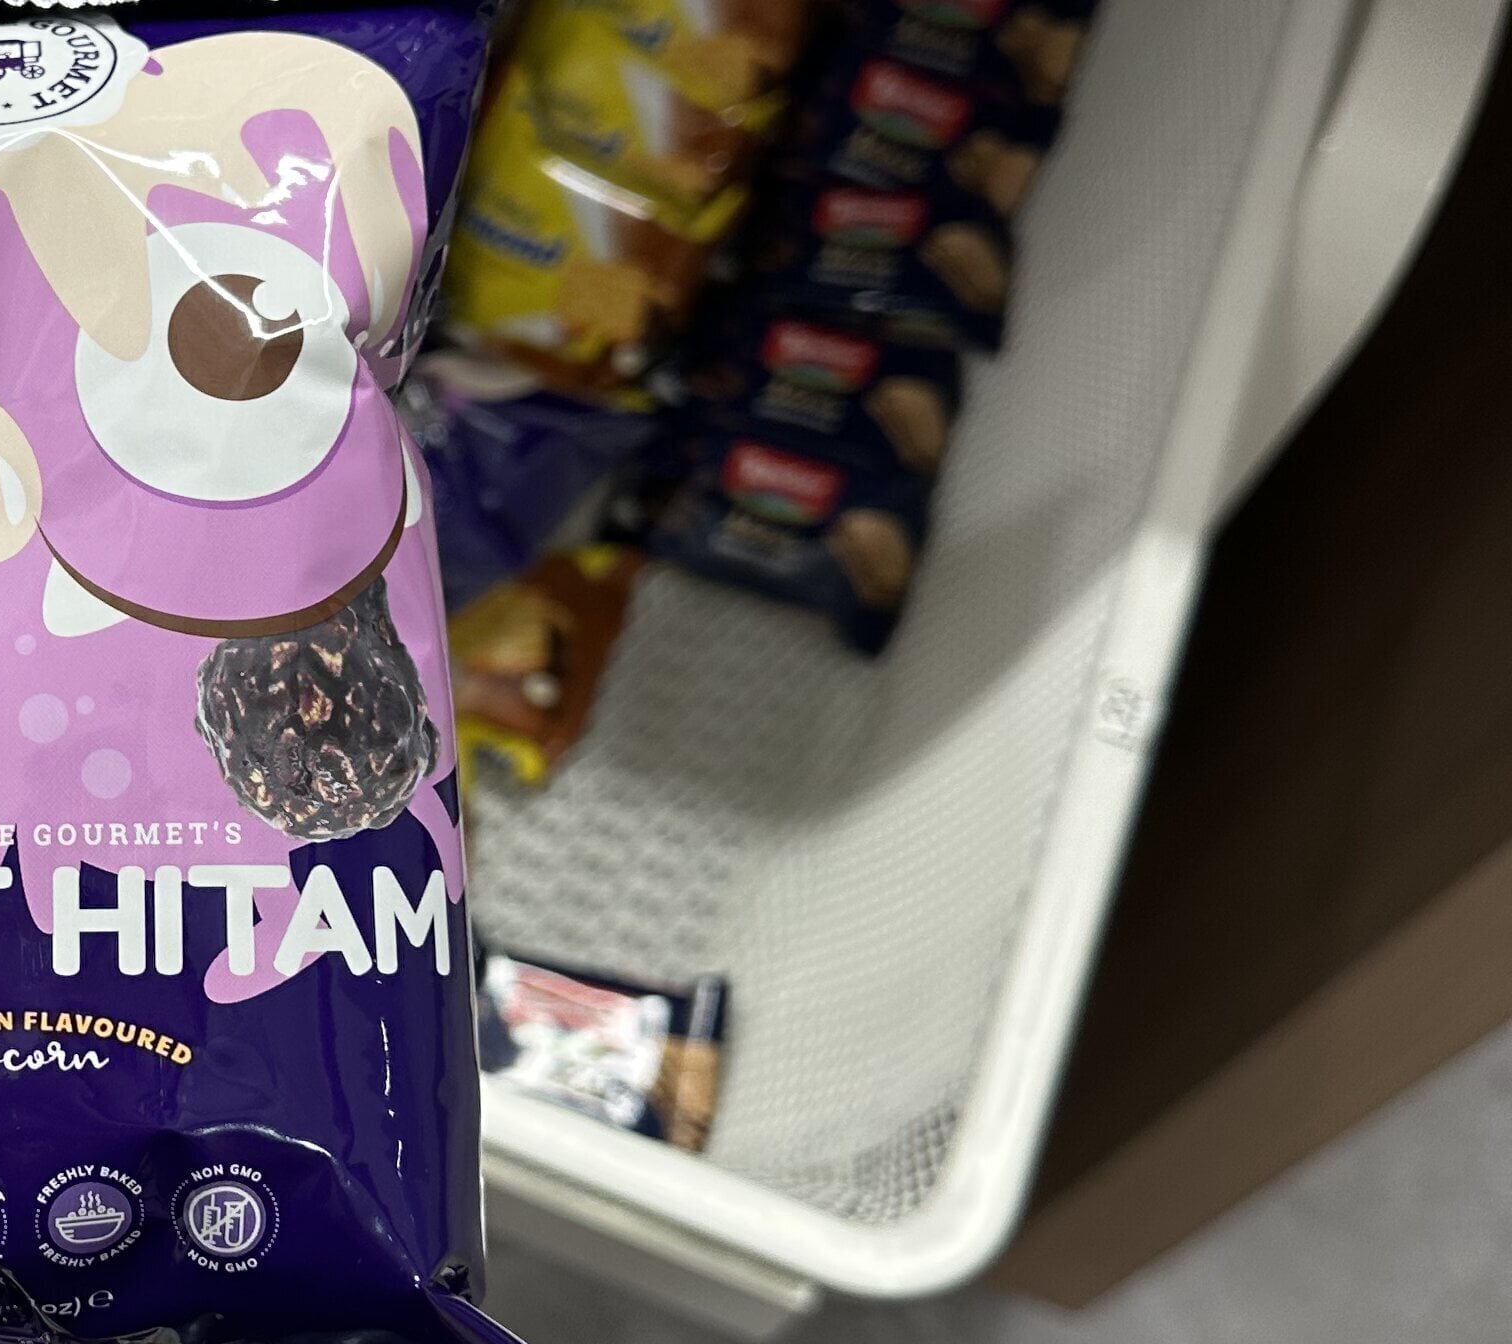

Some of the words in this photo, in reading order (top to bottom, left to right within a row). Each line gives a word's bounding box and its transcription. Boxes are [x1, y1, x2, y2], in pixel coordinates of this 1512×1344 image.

[28, 18, 100, 109] GOURMET
[32, 821, 243, 848] GOURMET'S
[50, 864, 451, 978] HITAM
[23, 1011, 192, 1065] FLAVOURED
[37, 1164, 95, 1205] FRESHLY
[99, 1165, 143, 1196] BAKED
[190, 1164, 225, 1183] NON
[229, 1164, 263, 1183] GMO
[38, 1241, 95, 1268] FRESHLY
[99, 1228, 142, 1263] BAKED
[187, 1248, 220, 1272] NON
[224, 1257, 259, 1273] GMO
